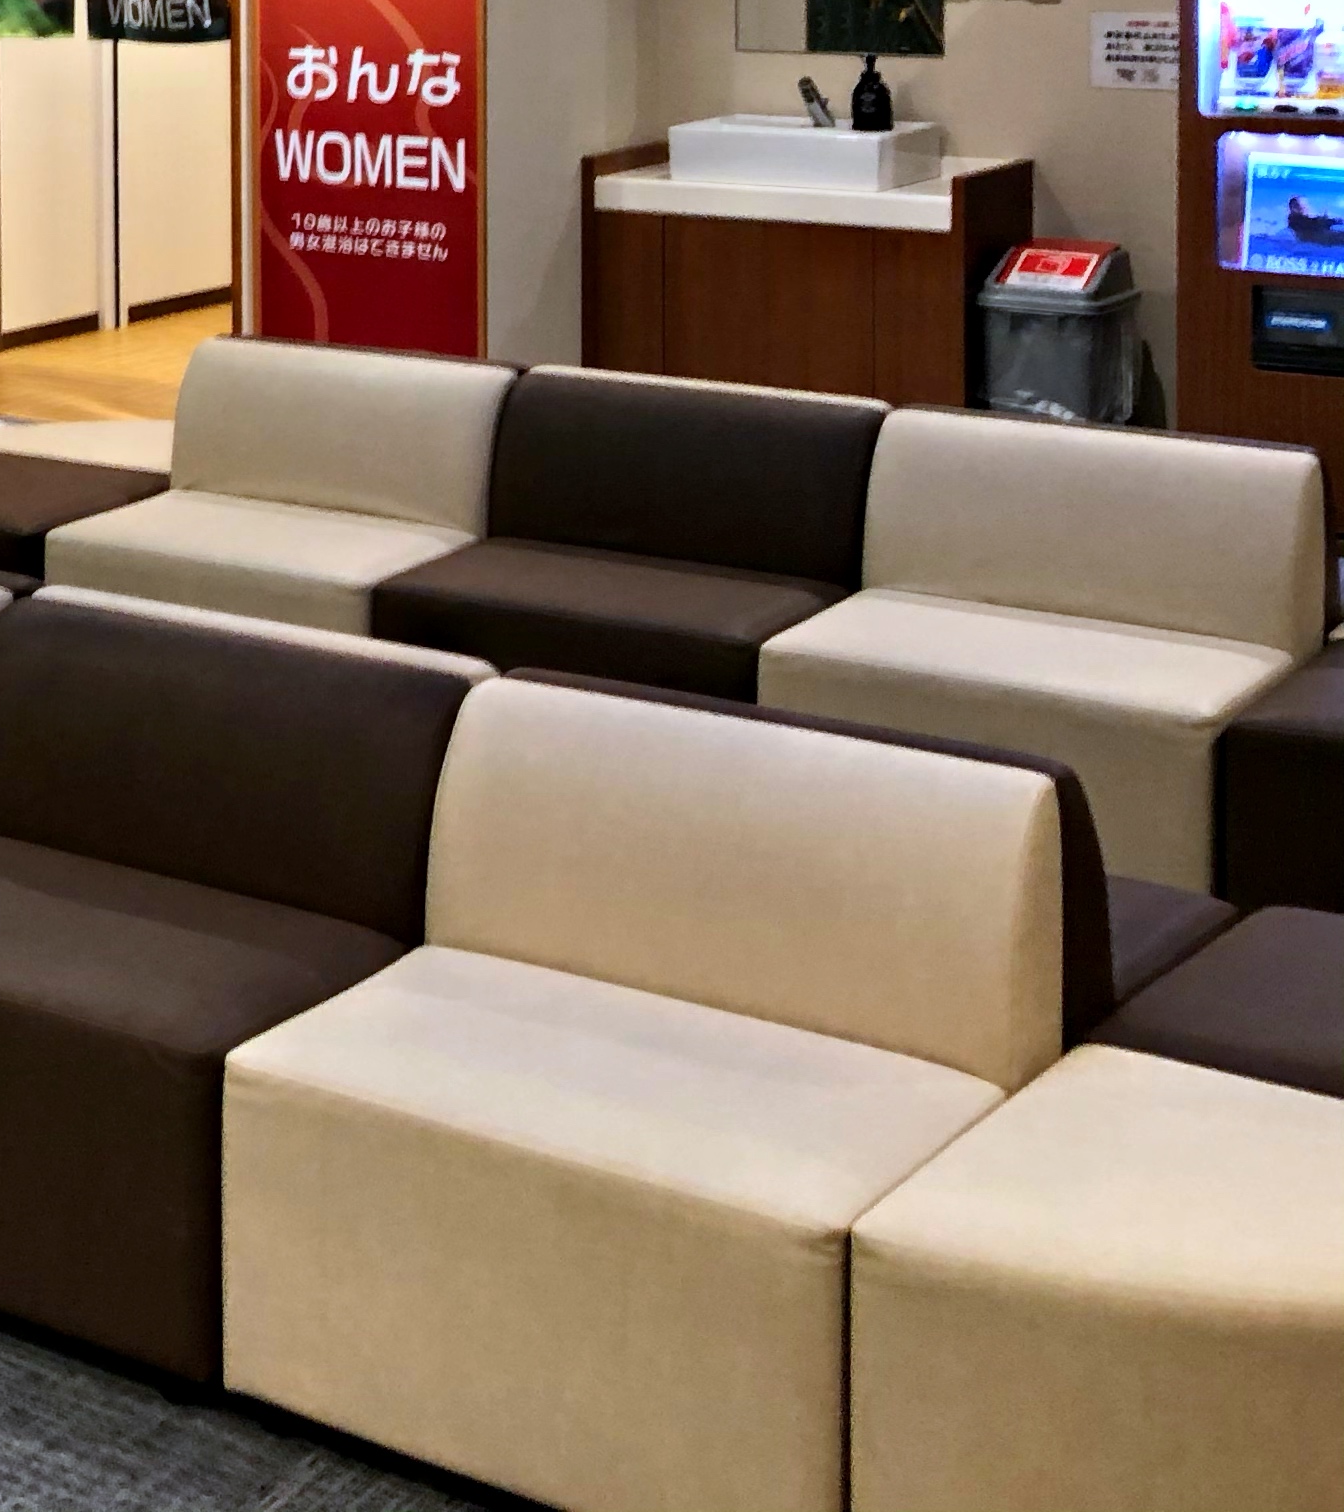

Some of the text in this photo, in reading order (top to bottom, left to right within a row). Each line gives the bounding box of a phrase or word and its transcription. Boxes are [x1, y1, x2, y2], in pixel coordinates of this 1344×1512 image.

[287, 45, 461, 107] おんな
[275, 128, 466, 193] WOMEN
[289, 231, 449, 262] 男女混浴はできません
[291, 212, 447, 242] 10歳以上のお子様の
